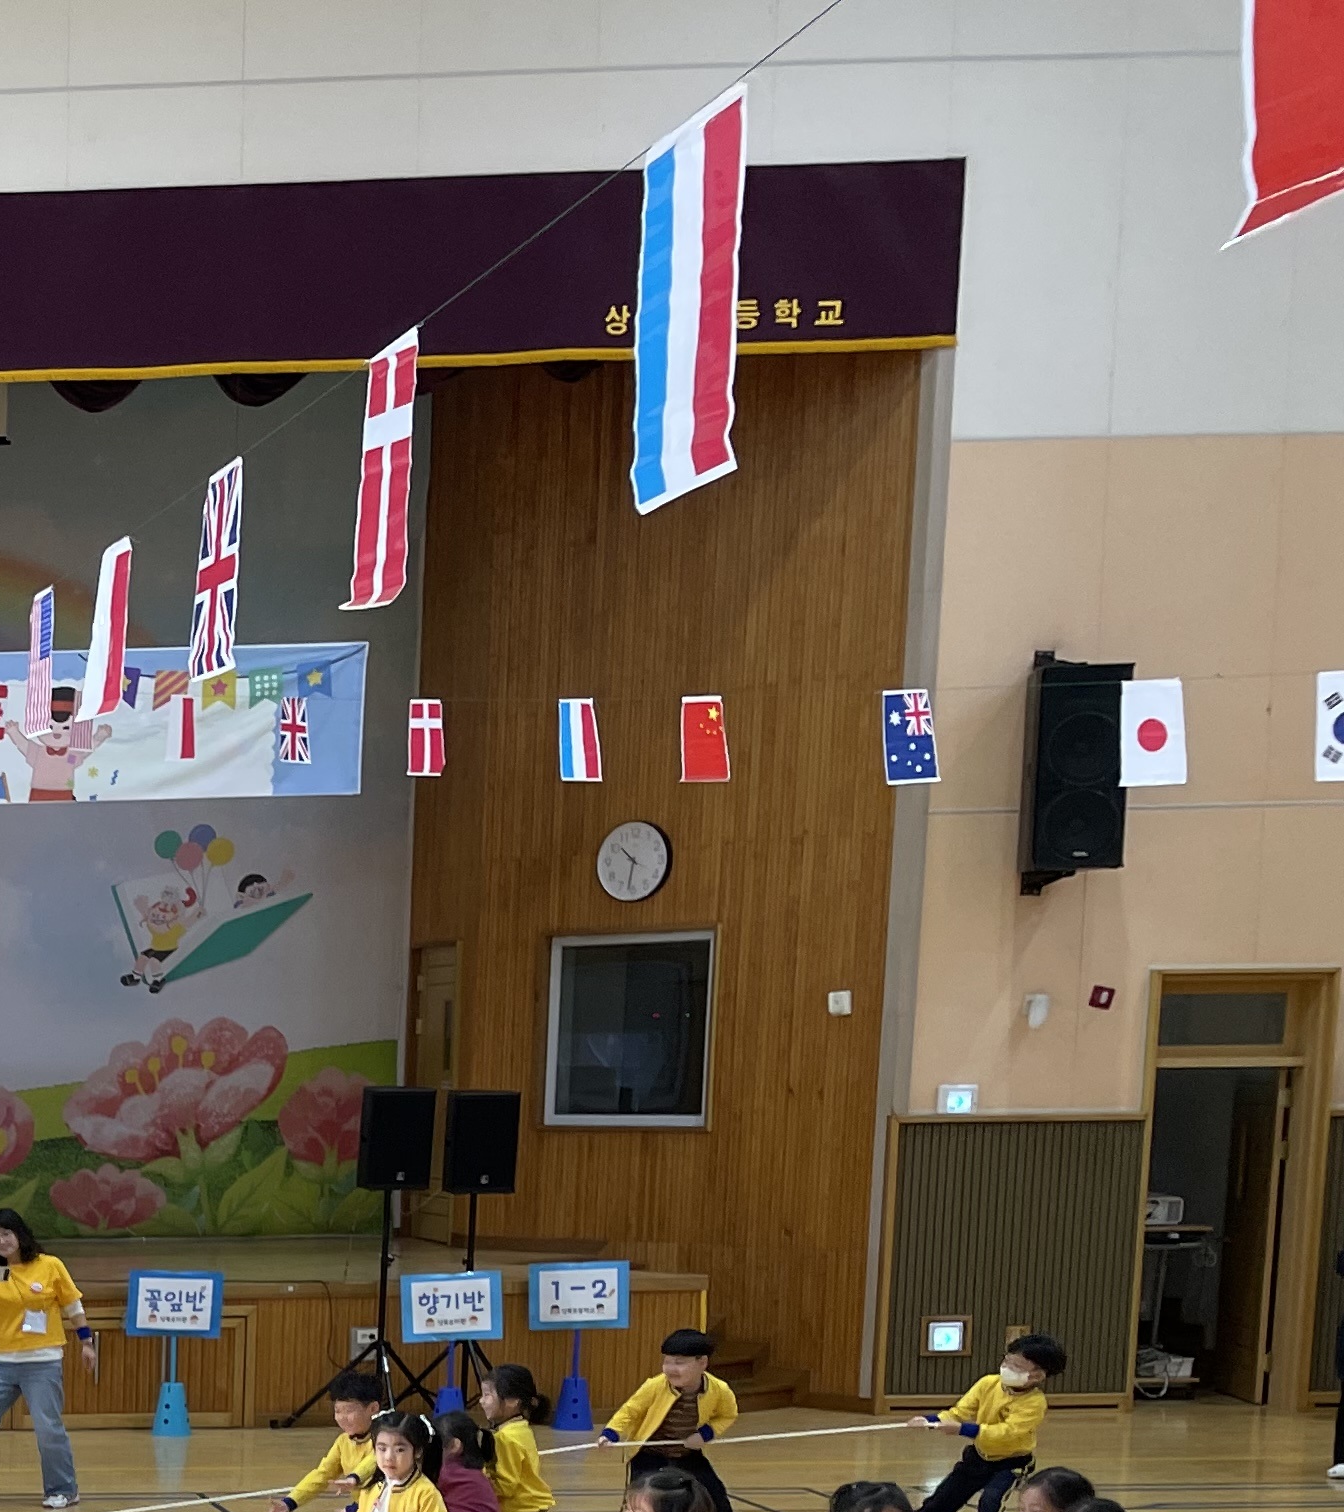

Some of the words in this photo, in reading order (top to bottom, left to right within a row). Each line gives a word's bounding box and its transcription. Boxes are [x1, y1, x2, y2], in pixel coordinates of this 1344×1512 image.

[605, 298, 844, 336] 상등학교
[145, 1288, 206, 1312] 꽃잎반
[418, 1290, 485, 1315] 향기반
